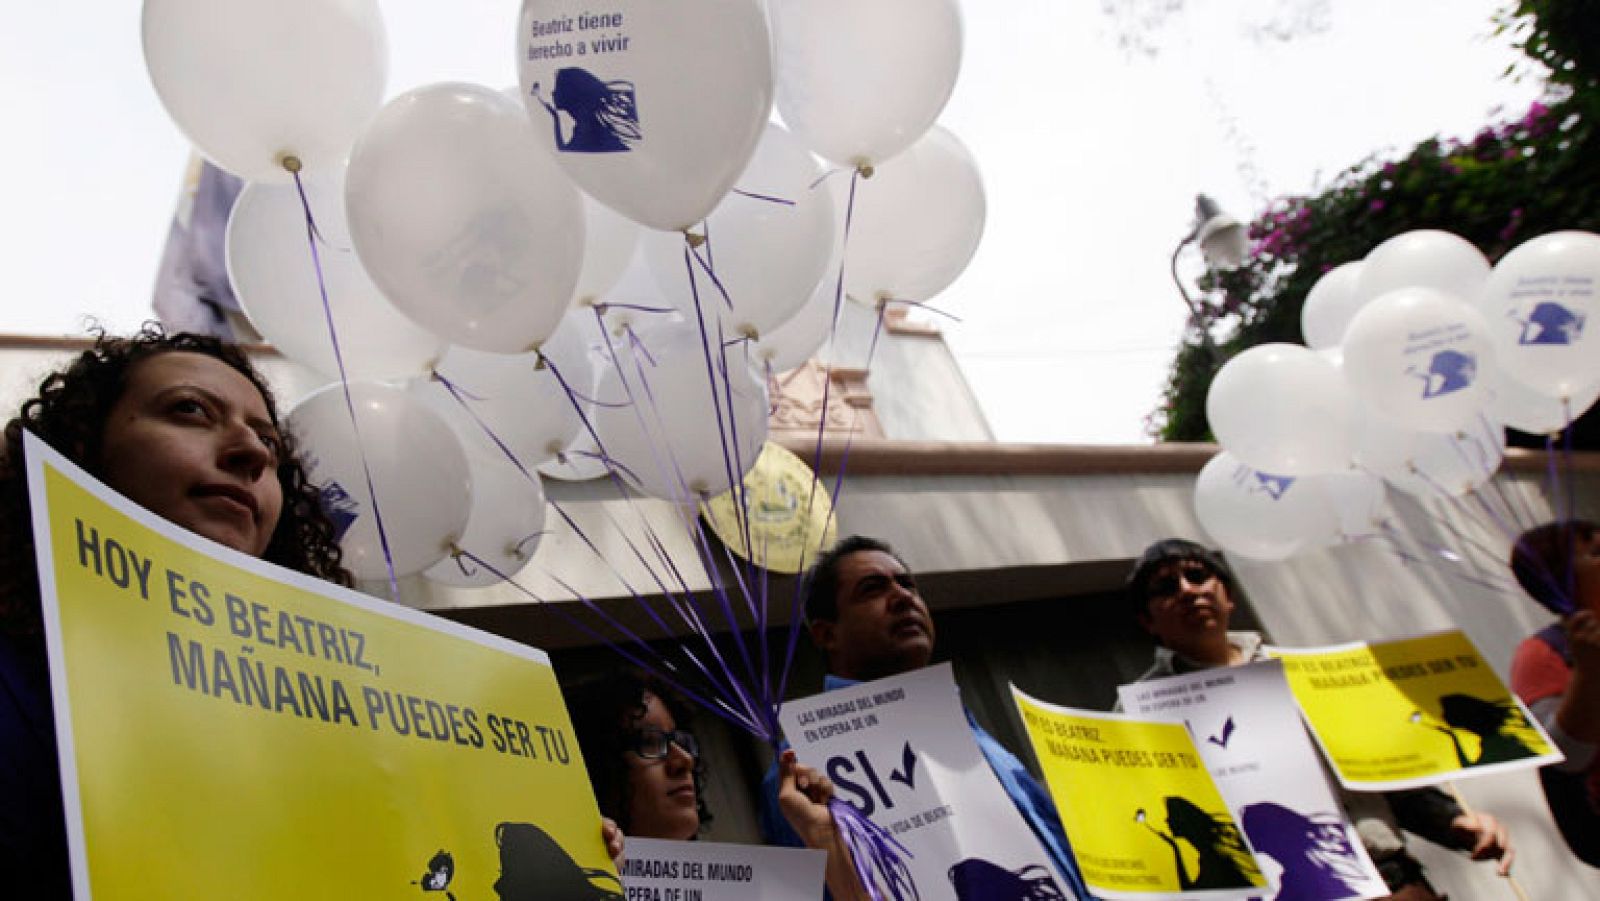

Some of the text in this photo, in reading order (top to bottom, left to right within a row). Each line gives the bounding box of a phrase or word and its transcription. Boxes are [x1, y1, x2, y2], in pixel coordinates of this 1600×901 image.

[532, 11, 623, 38] Beatriz tiene
[577, 41, 586, 56] a
[591, 33, 630, 53] vivir
[74, 517, 380, 677] HOY ES BEATRIZ,
[166, 631, 570, 765] MAÑANA PUEDES SER TU
[798, 687, 905, 726] LAS MIRADAS DEL MUNDO
[804, 713, 880, 743] EN ESPERA DE UN
[826, 750, 894, 818] SI
[683, 862, 705, 879] DEL
[708, 863, 753, 883] MUNDO
[664, 887, 683, 901] DE
